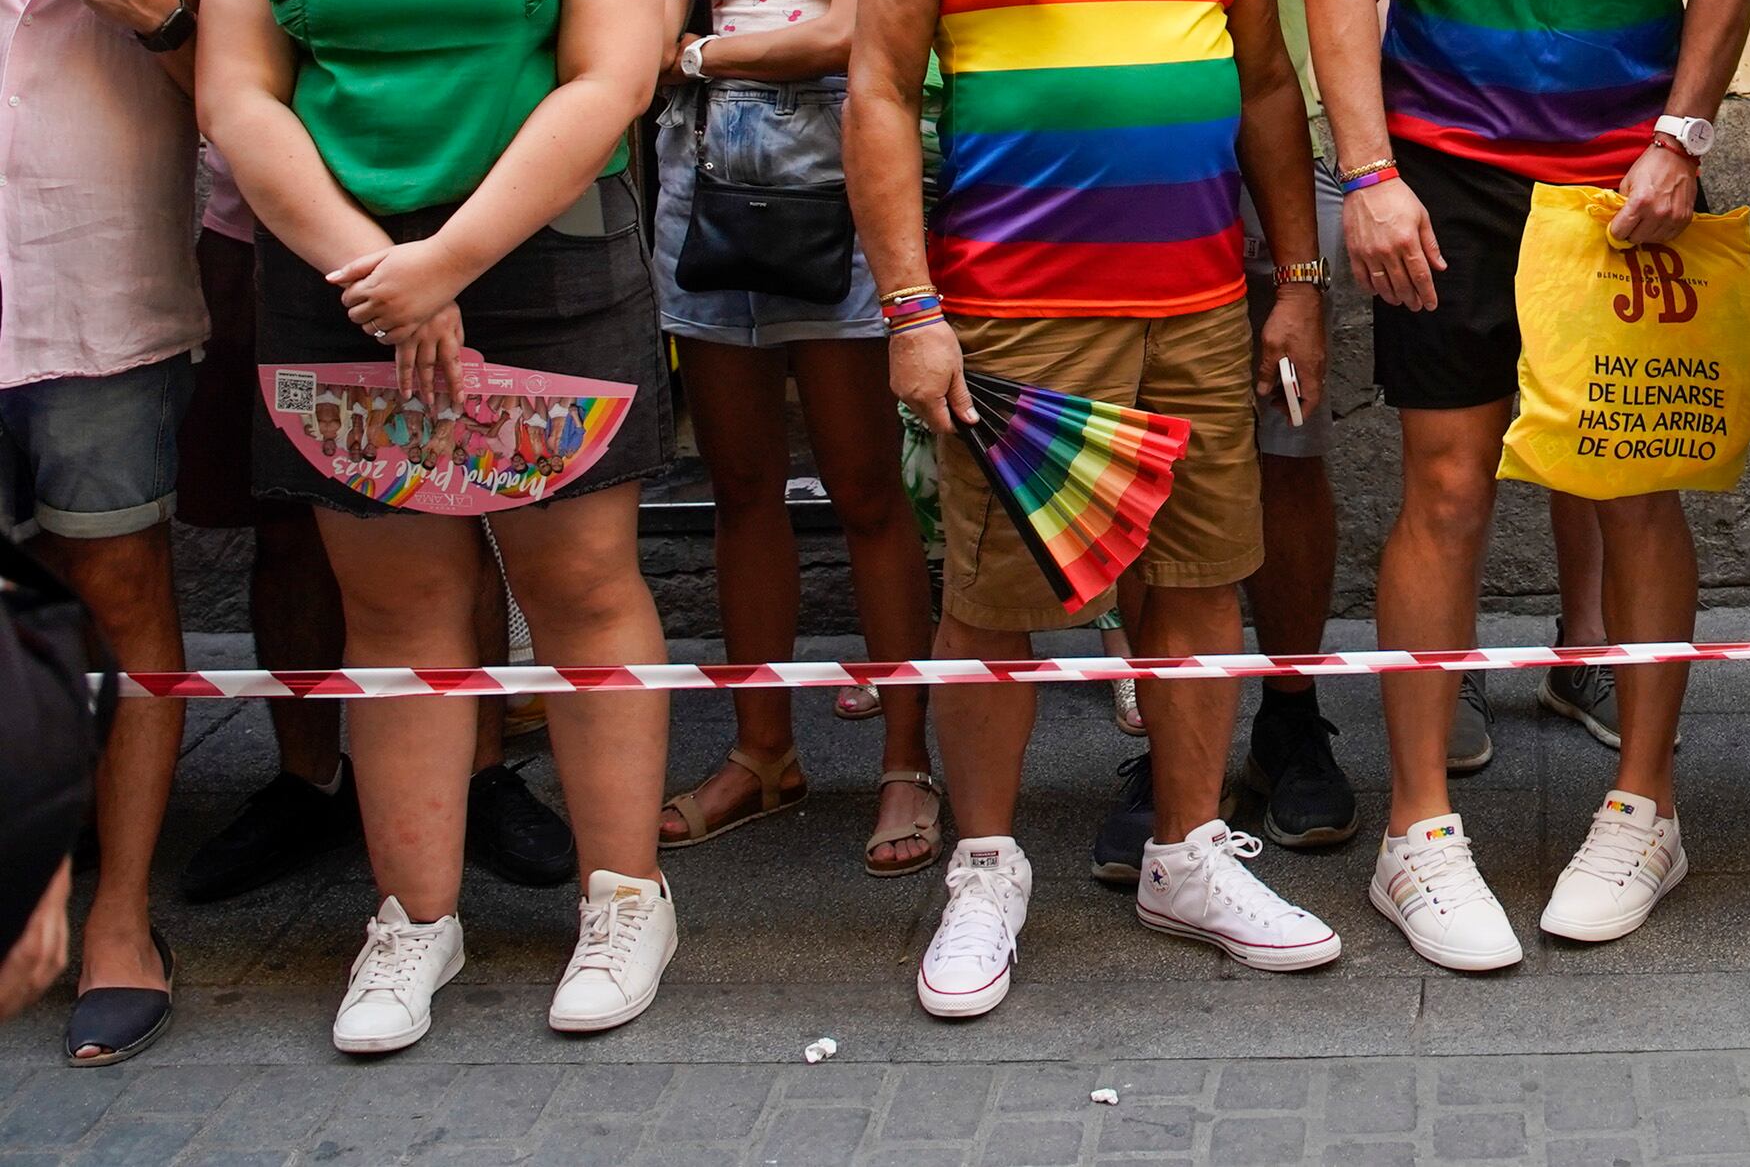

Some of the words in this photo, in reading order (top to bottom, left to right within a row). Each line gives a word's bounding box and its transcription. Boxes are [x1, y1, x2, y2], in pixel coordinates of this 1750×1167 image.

[1597, 272, 1630, 282] BLENDE
[1594, 355, 1638, 377] HAY
[1645, 357, 1720, 381] GANAS
[1589, 383, 1616, 403] DE
[1623, 385, 1725, 408] LLENARSE
[1578, 410, 1646, 432] HASTA
[1652, 411, 1727, 436] ARRIBA
[1577, 436, 1608, 457] DE
[1614, 438, 1716, 461] ORGULLO
[332, 456, 387, 479] 2023
[396, 461, 453, 491] Pride
[461, 465, 546, 502] Madrid
